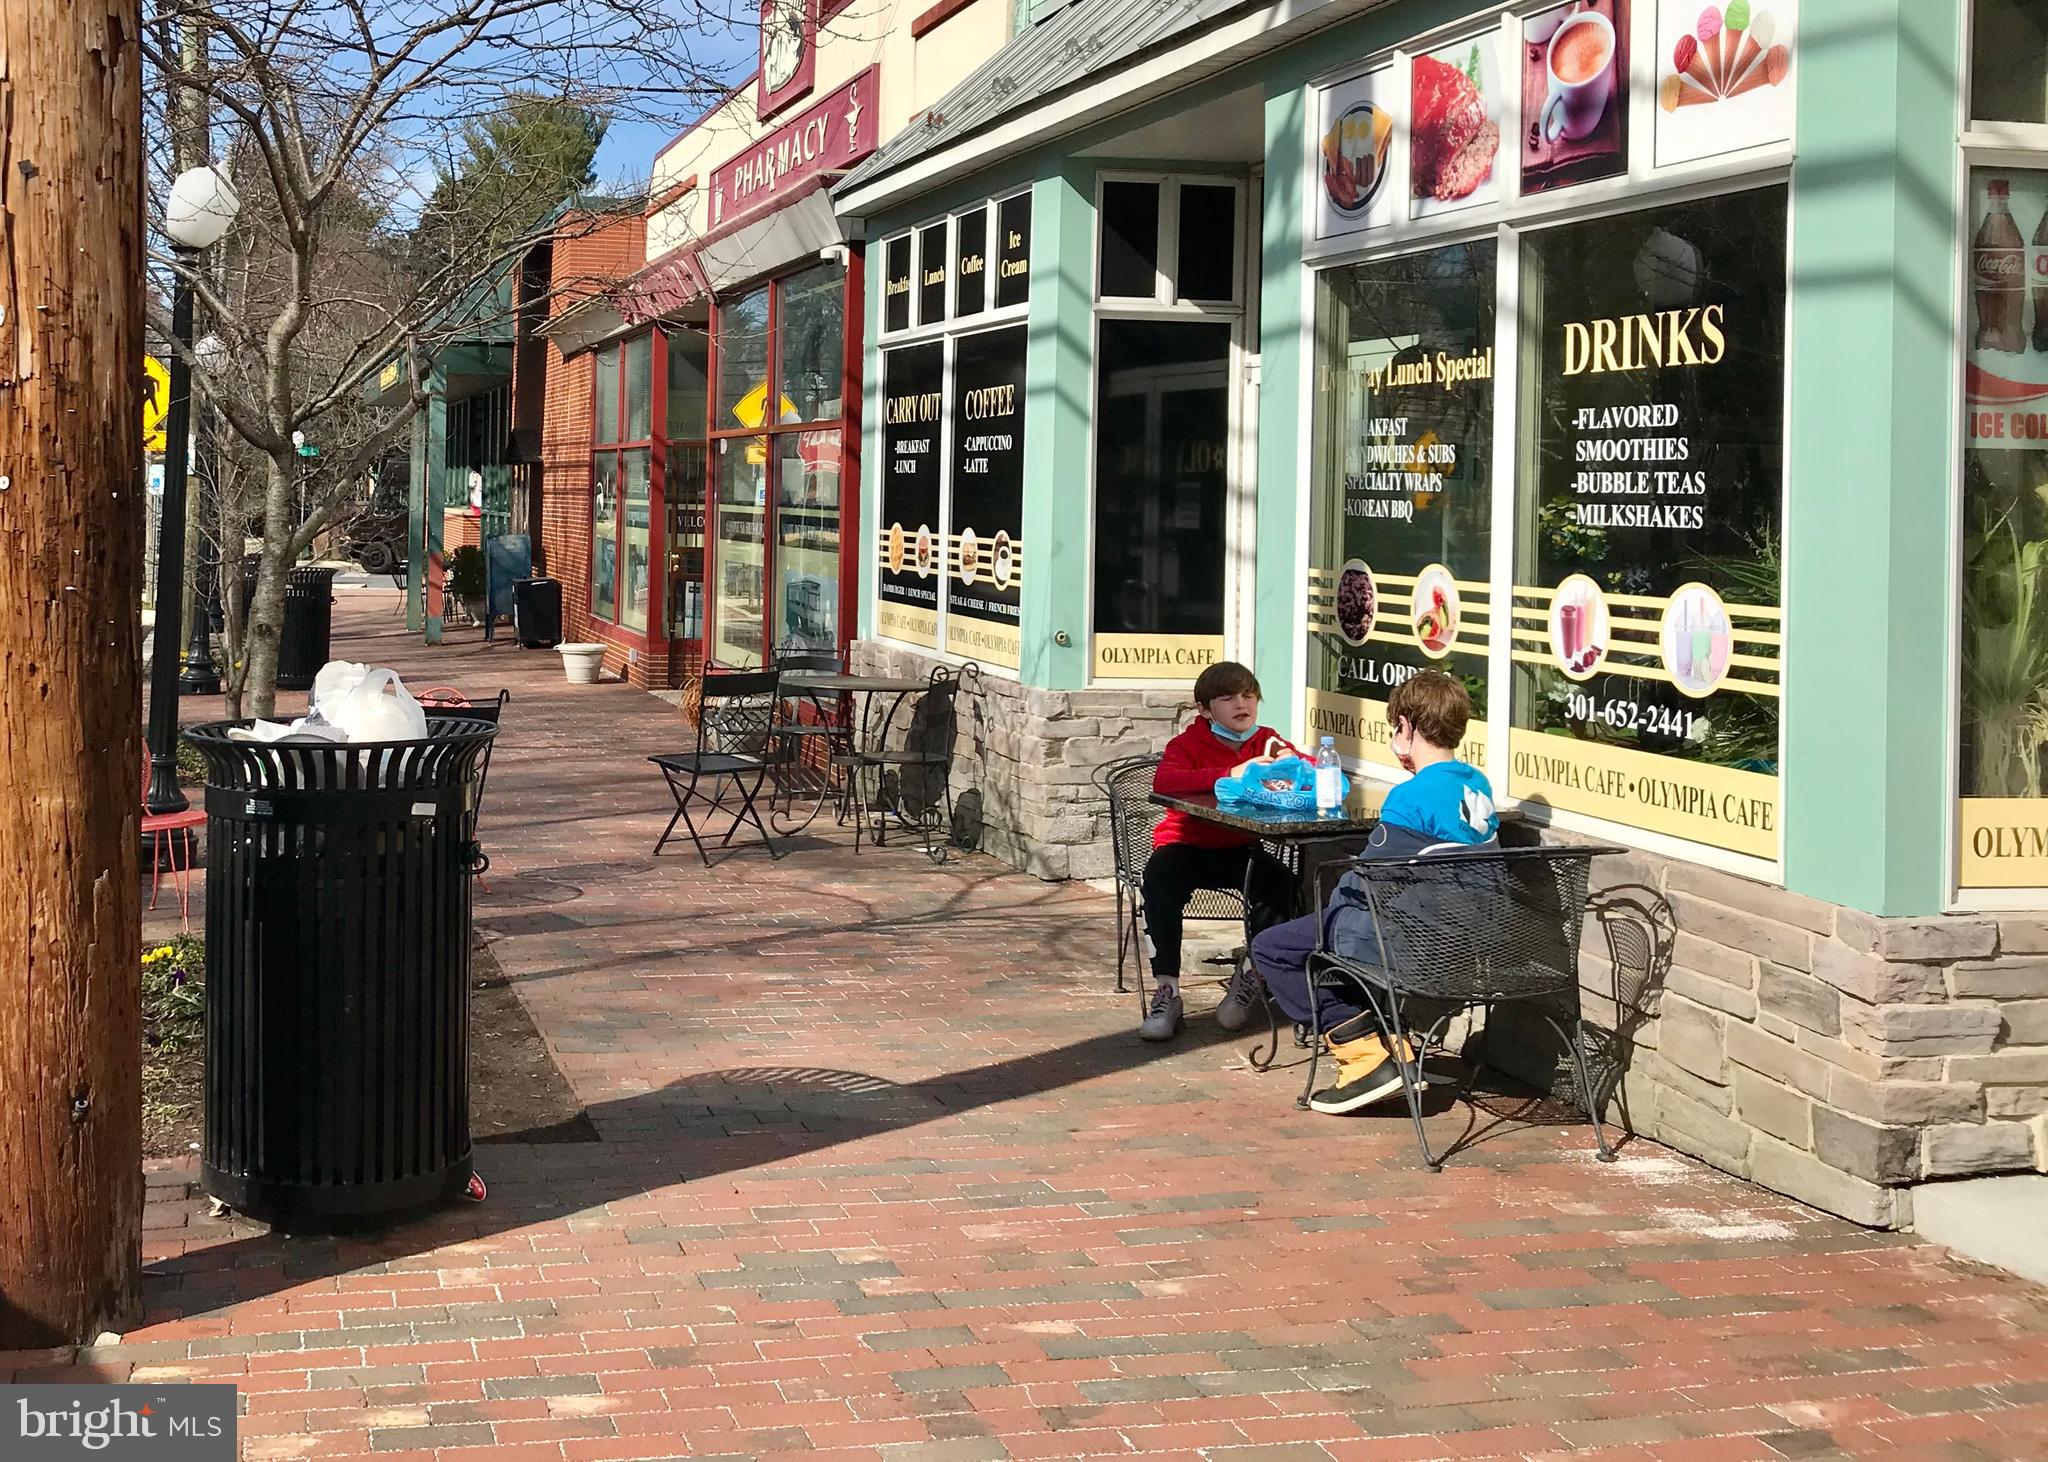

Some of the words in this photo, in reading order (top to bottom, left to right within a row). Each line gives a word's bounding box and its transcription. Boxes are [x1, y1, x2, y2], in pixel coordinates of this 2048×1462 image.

[734, 112, 829, 201] PHARMACY
[1009, 230, 1021, 249] Ice
[924, 266, 945, 286] Lunch
[961, 254, 984, 275] Coffee
[1001, 259, 1027, 278] Cream
[1563, 304, 1725, 376] DRINKS
[1387, 354, 1432, 387] Lunch
[1436, 347, 1492, 391] Special
[886, 395, 918, 424] CARRY
[920, 393, 941, 422] OUT
[965, 384, 1014, 420] COFFEE
[1572, 404, 1679, 430] -FLAVORED
[1970, 412, 2004, 439] ICE
[894, 439, 930, 454] -BREAKFAST
[964, 434, 1012, 451] -CAPPUCCINO
[1417, 446, 1425, 463] &
[1428, 444, 1456, 463] SUBS
[1576, 437, 1688, 462] SMOOTHIES
[894, 460, 916, 473] -LUNCH
[963, 458, 988, 473] -LATTE
[1404, 473, 1442, 493] WRAPS
[1571, 471, 1649, 494] -BUBBLE
[1653, 471, 1706, 495] TEAS
[1391, 500, 1413, 524] BBQ
[988, 601, 1006, 614] FRENCH
[1102, 647, 1171, 664] OLYMPIA
[1176, 648, 1215, 665] CAFE
[1338, 655, 1379, 682] CALL
[1564, 691, 1694, 740] 301-652-2441
[1309, 707, 1356, 738] OLYMPIA
[1358, 717, 1387, 744] CAFE
[1461, 741, 1485, 767] AFE
[1514, 751, 1581, 791] OLYMPIA
[1584, 766, 1625, 798] CAFE
[1638, 778, 1719, 819] OLYMPIA
[1722, 793, 1773, 832] CAFE
